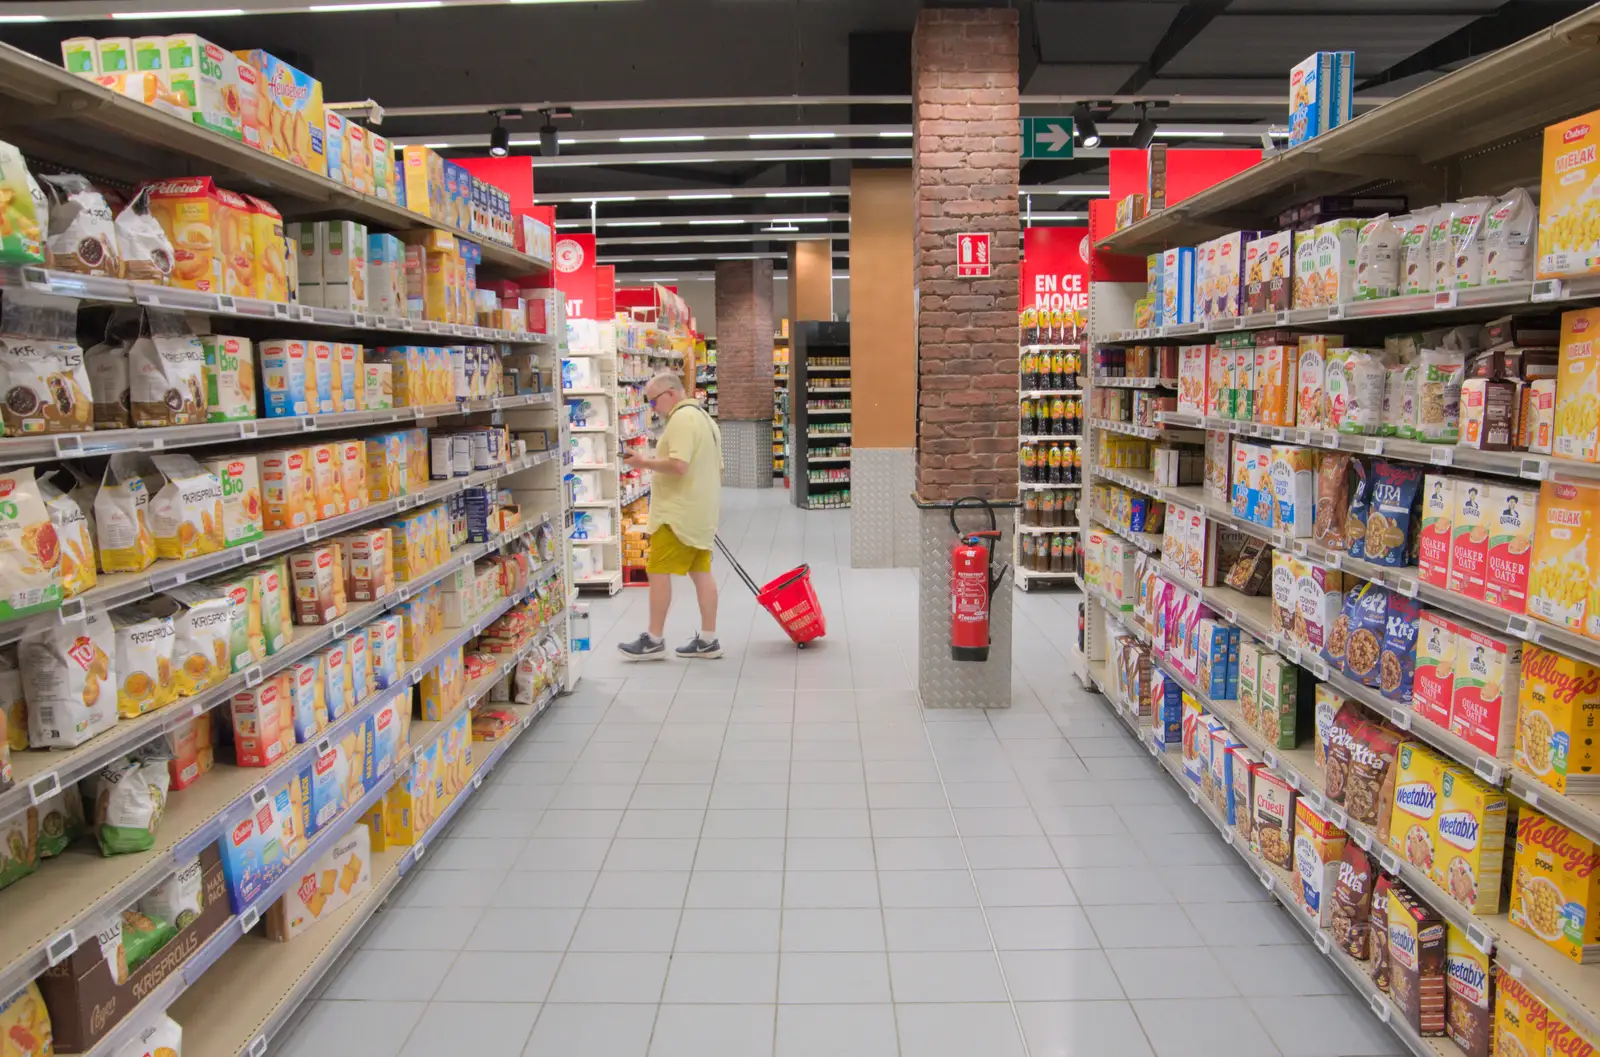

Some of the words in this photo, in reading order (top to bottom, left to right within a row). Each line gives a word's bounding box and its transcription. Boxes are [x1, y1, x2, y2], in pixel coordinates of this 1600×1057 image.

[199, 46, 221, 80] Bio
[1556, 145, 1596, 173] MIELAK
[1035, 275, 1056, 291] EN
[1062, 275, 1081, 291] CE
[219, 344, 238, 372] Bio
[221, 469, 243, 496] Bio
[182, 485, 222, 505] KRISPROLLS
[1429, 501, 1444, 510] QUAKER
[1462, 508, 1481, 518] QUAKER
[1500, 516, 1521, 528] QUAKER
[1422, 537, 1446, 552] QUAKER
[1424, 549, 1440, 560] OATS
[1454, 545, 1483, 563] QUAKER
[1458, 558, 1476, 571] OATS
[1490, 556, 1525, 575] QUAKER
[1494, 569, 1516, 584] OATS
[1302, 603, 1315, 615] CRISP
[1420, 676, 1442, 694] QUAKER
[1423, 687, 1436, 699] OATS
[1462, 698, 1488, 718] QUAKER
[1465, 710, 1482, 724] OATS
[1257, 794, 1285, 817] Cruesli
[1396, 786, 1437, 809] Weetabix
[1438, 816, 1479, 841] Weetabix
[1535, 858, 1553, 872] pops
[207, 870, 225, 890] MAXI
[1338, 861, 1363, 893] extra
[208, 888, 227, 905] PACK
[300, 876, 316, 899] TOP
[1422, 940, 1439, 948] CHOCO
[132, 931, 198, 1000] KRISPROLLS
[1446, 958, 1486, 990] Weetabix
